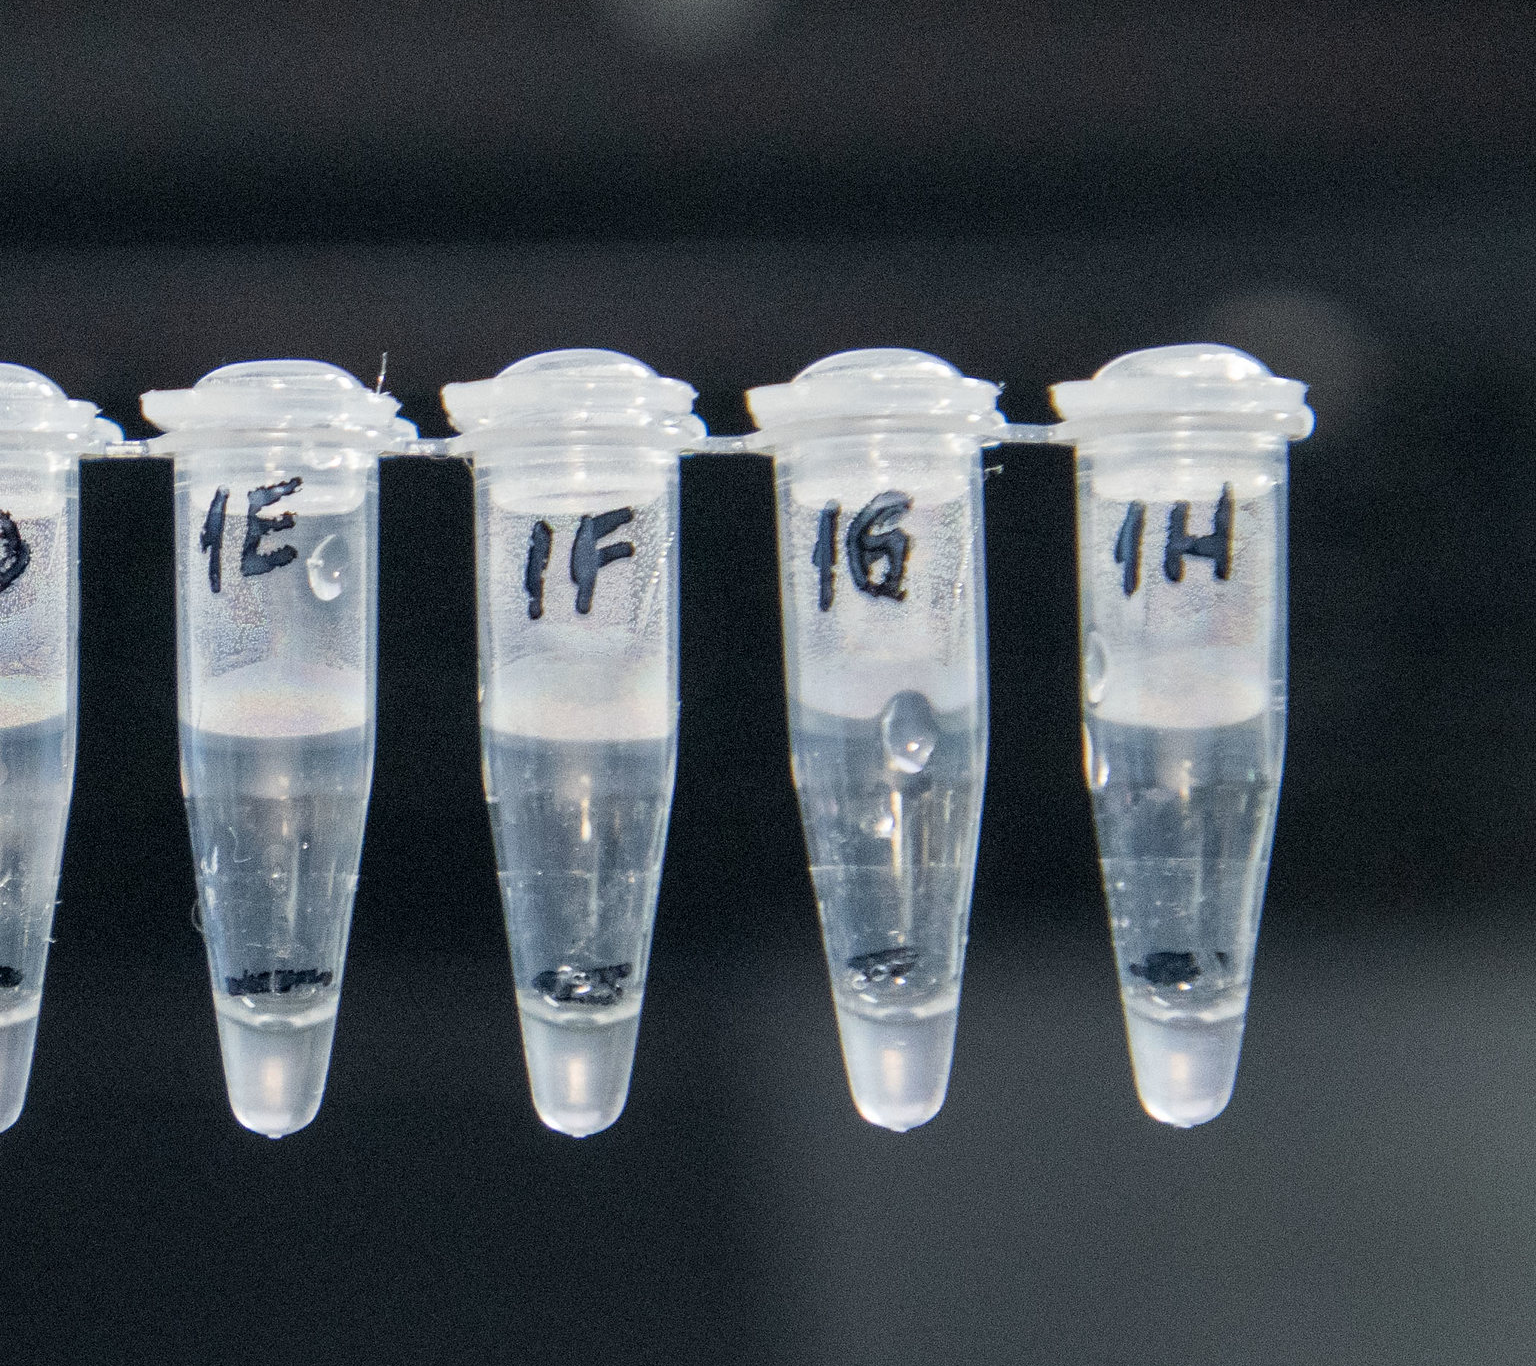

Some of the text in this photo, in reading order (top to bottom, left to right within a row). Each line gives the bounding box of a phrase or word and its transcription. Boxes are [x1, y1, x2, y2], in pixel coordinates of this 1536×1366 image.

[200, 476, 303, 594] 1E
[524, 507, 635, 621] 1F
[1114, 481, 1233, 597] 1H
